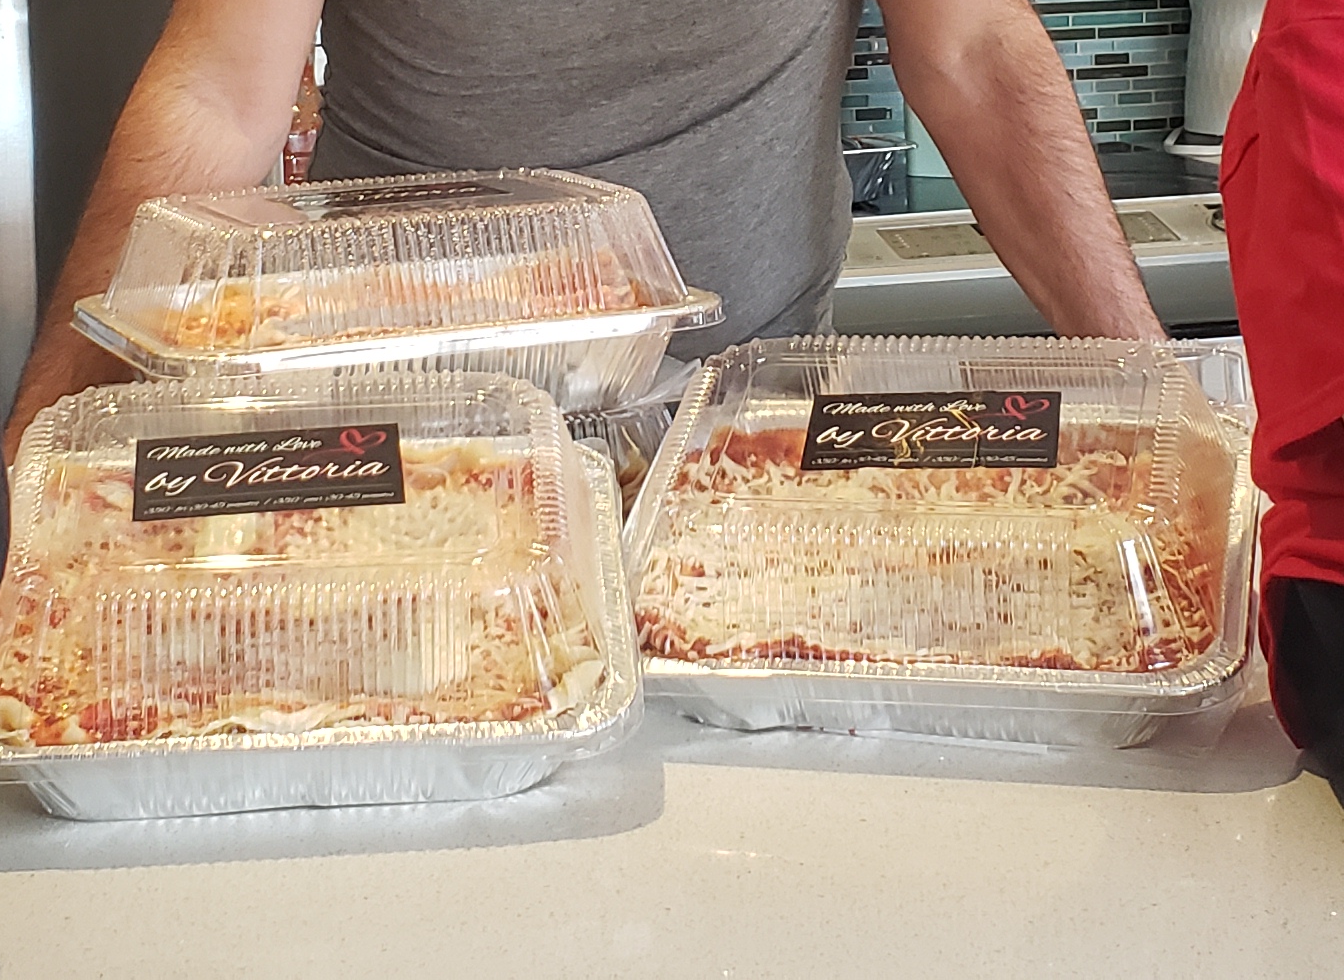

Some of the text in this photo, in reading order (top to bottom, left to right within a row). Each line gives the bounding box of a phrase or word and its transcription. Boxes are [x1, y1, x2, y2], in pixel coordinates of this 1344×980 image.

[822, 399, 988, 416] Made with Love
[815, 417, 1048, 449] by Vittoria
[146, 436, 323, 461] Made with Love
[144, 456, 391, 497] by Vittoria
